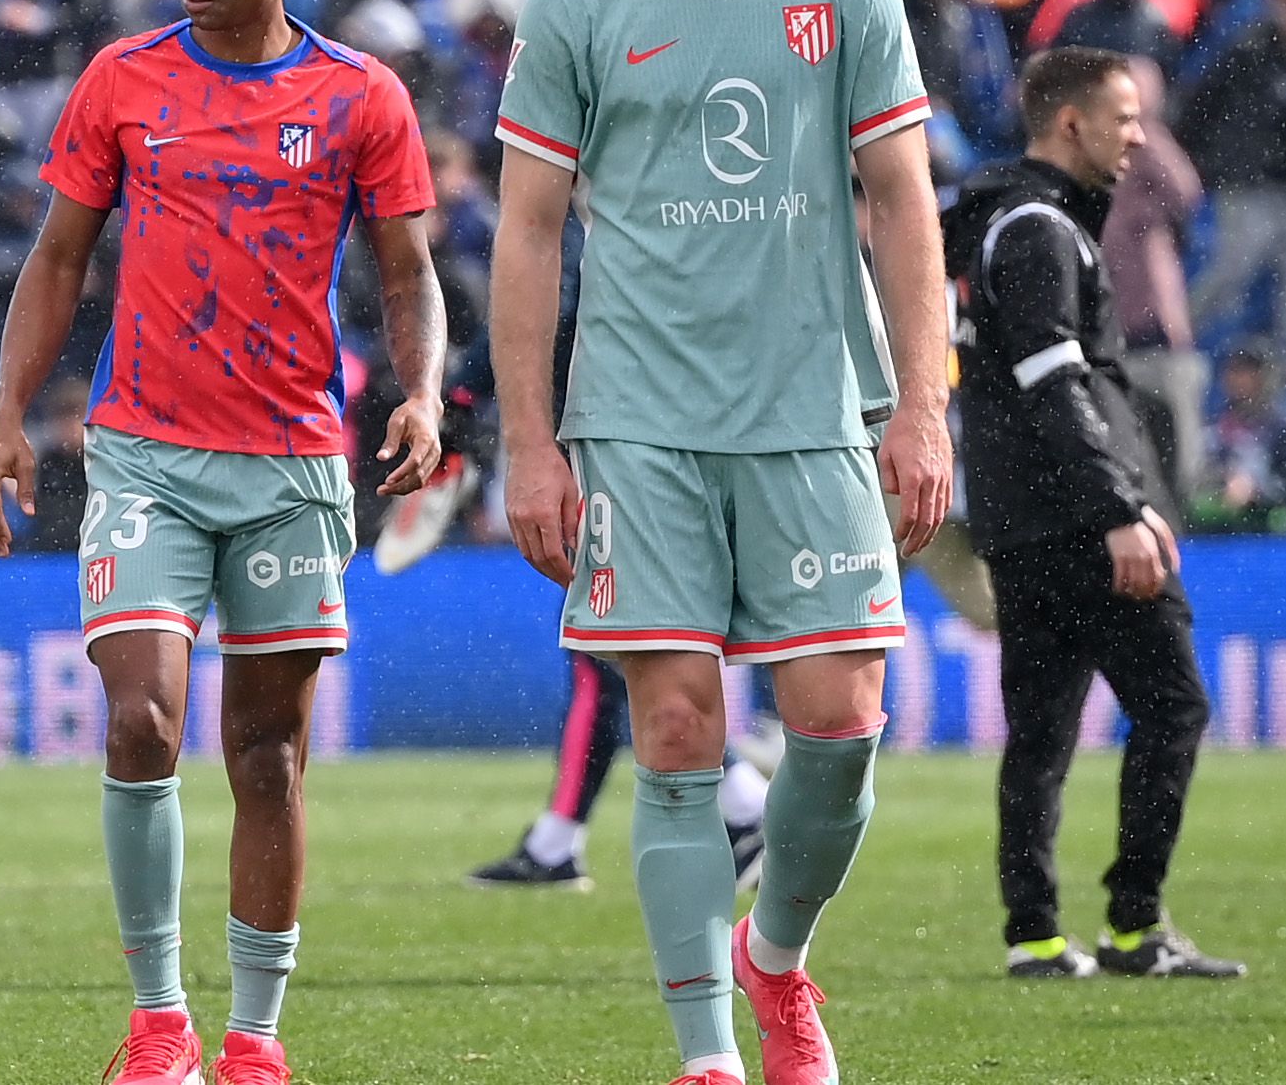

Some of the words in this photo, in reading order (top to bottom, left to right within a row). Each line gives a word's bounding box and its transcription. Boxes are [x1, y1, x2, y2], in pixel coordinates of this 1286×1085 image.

[661, 197, 764, 226] RIYADH
[774, 193, 807, 219] AIR
[82, 490, 153, 558] 23
[589, 492, 612, 564] 9
